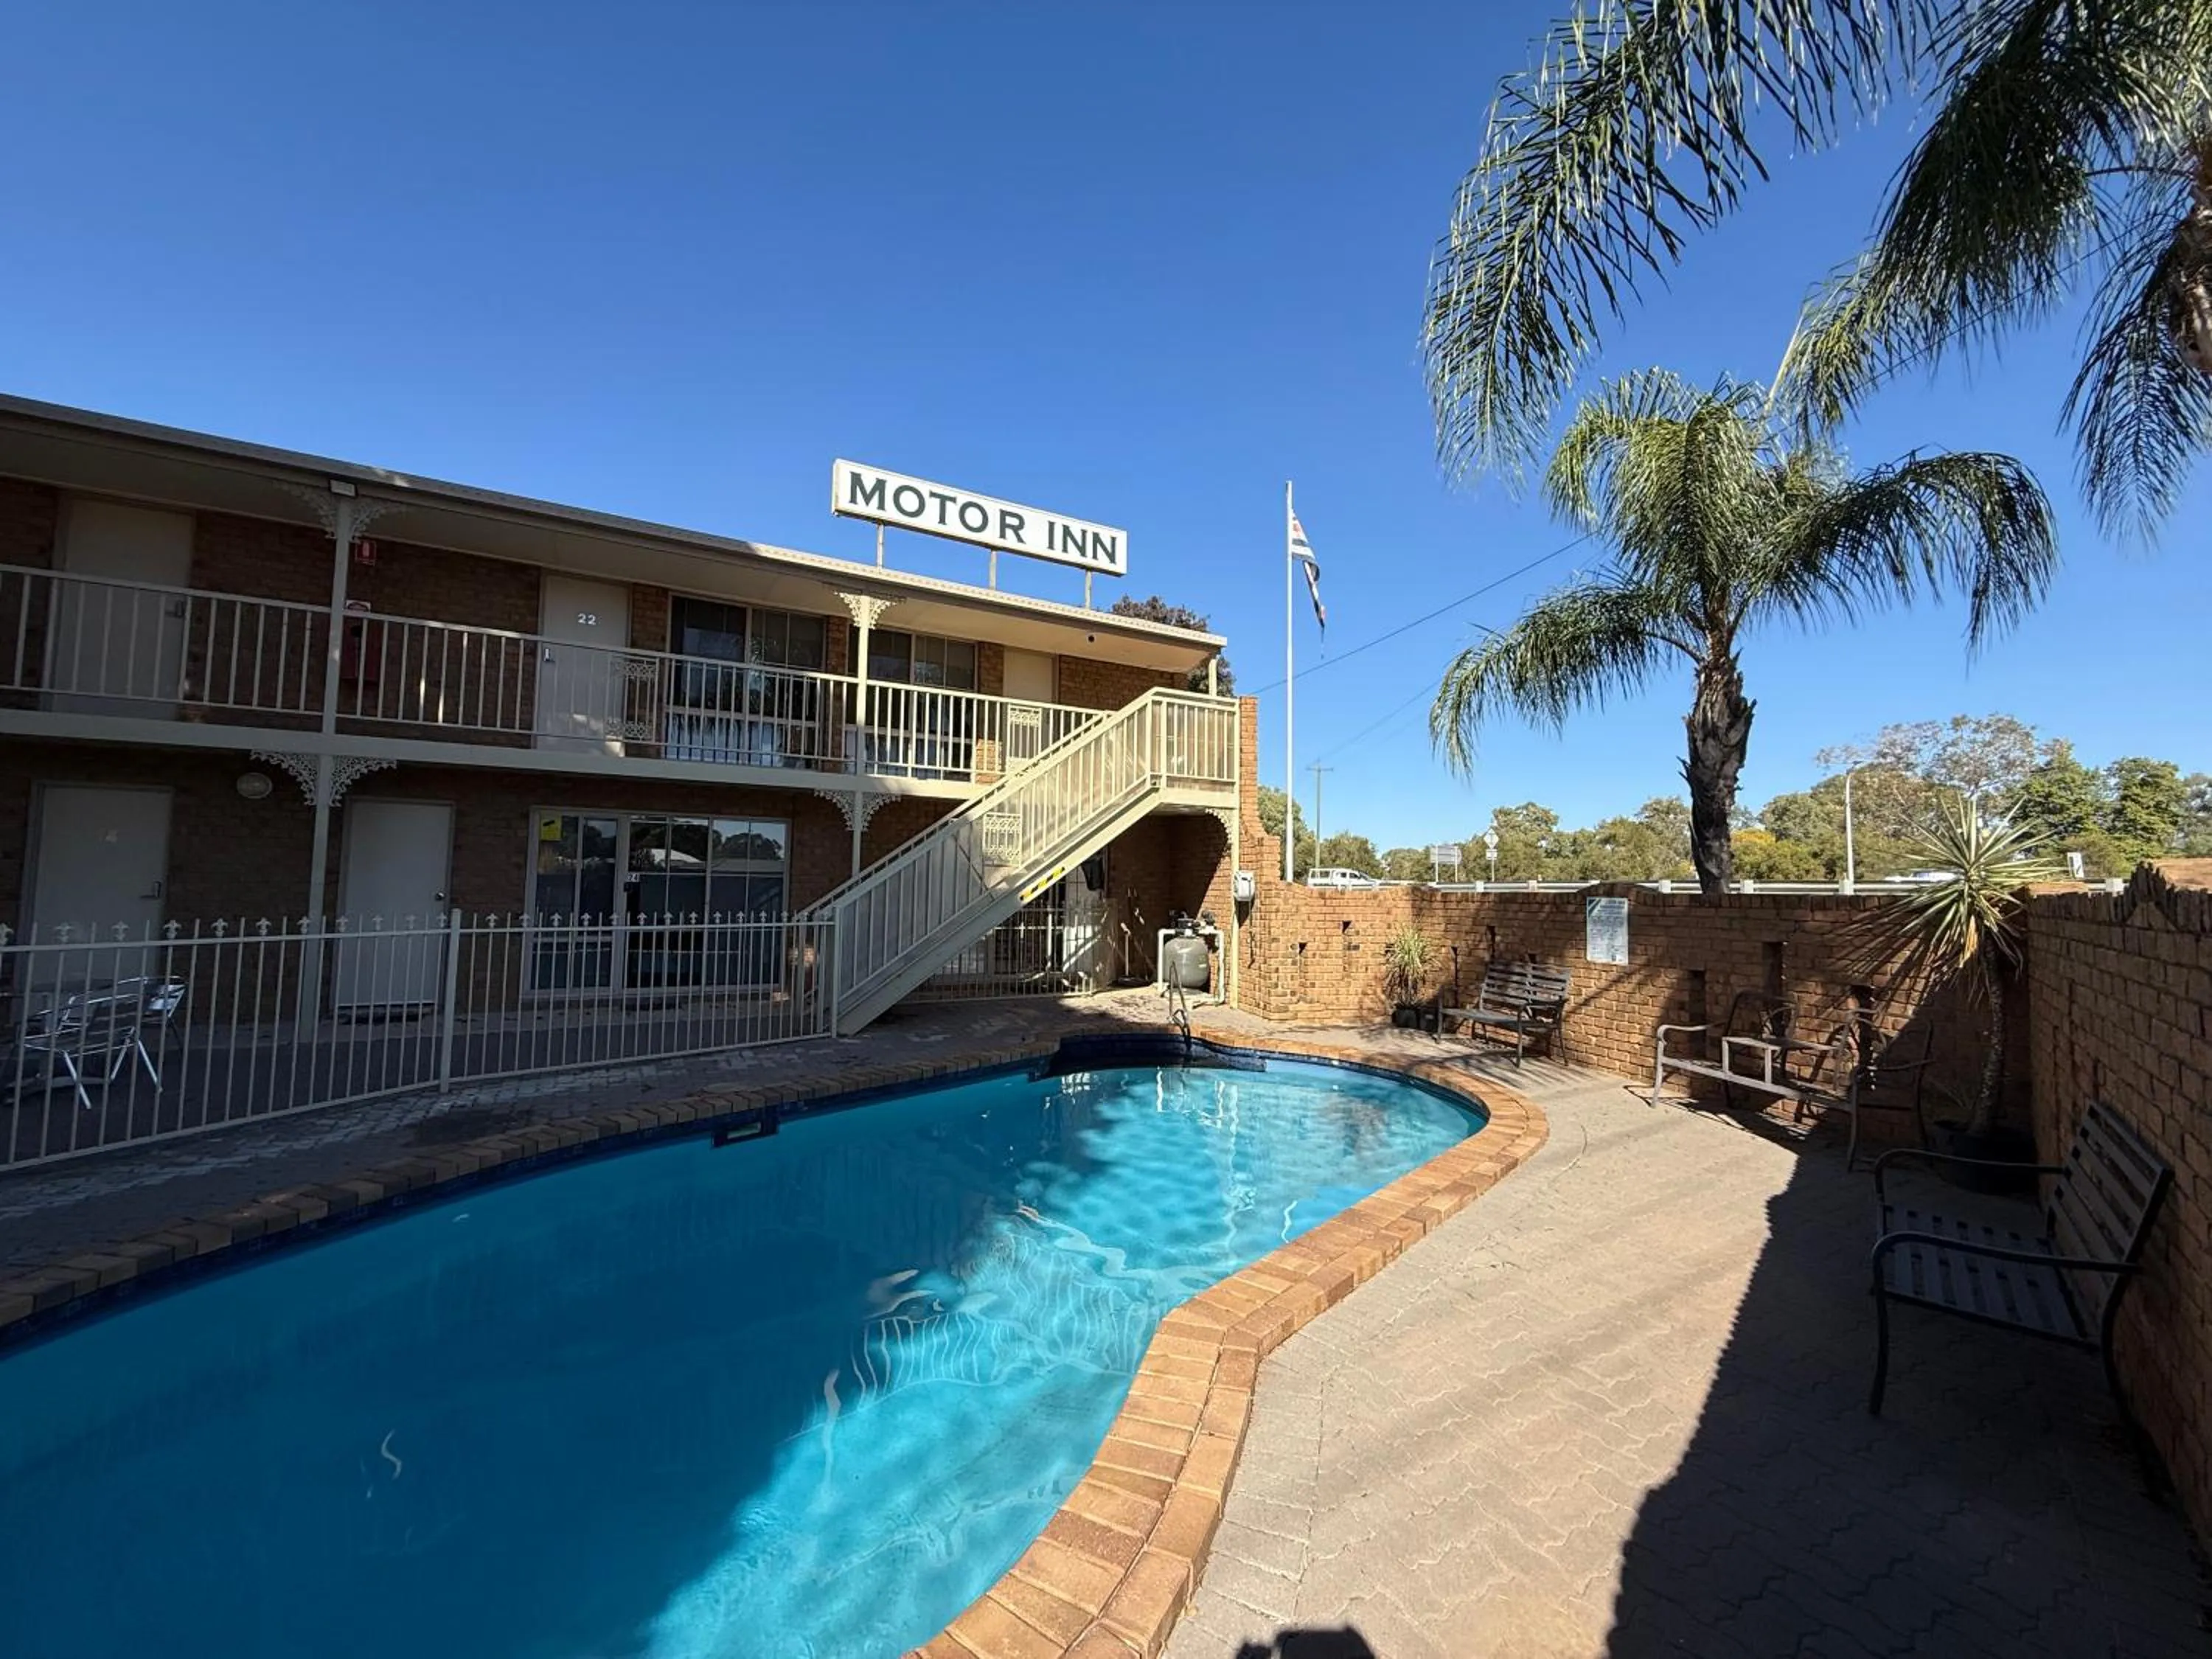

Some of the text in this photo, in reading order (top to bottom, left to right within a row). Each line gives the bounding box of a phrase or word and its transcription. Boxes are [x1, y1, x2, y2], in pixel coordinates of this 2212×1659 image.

[849, 470, 1117, 565] MOTOR INN
[577, 613, 597, 626] 22
